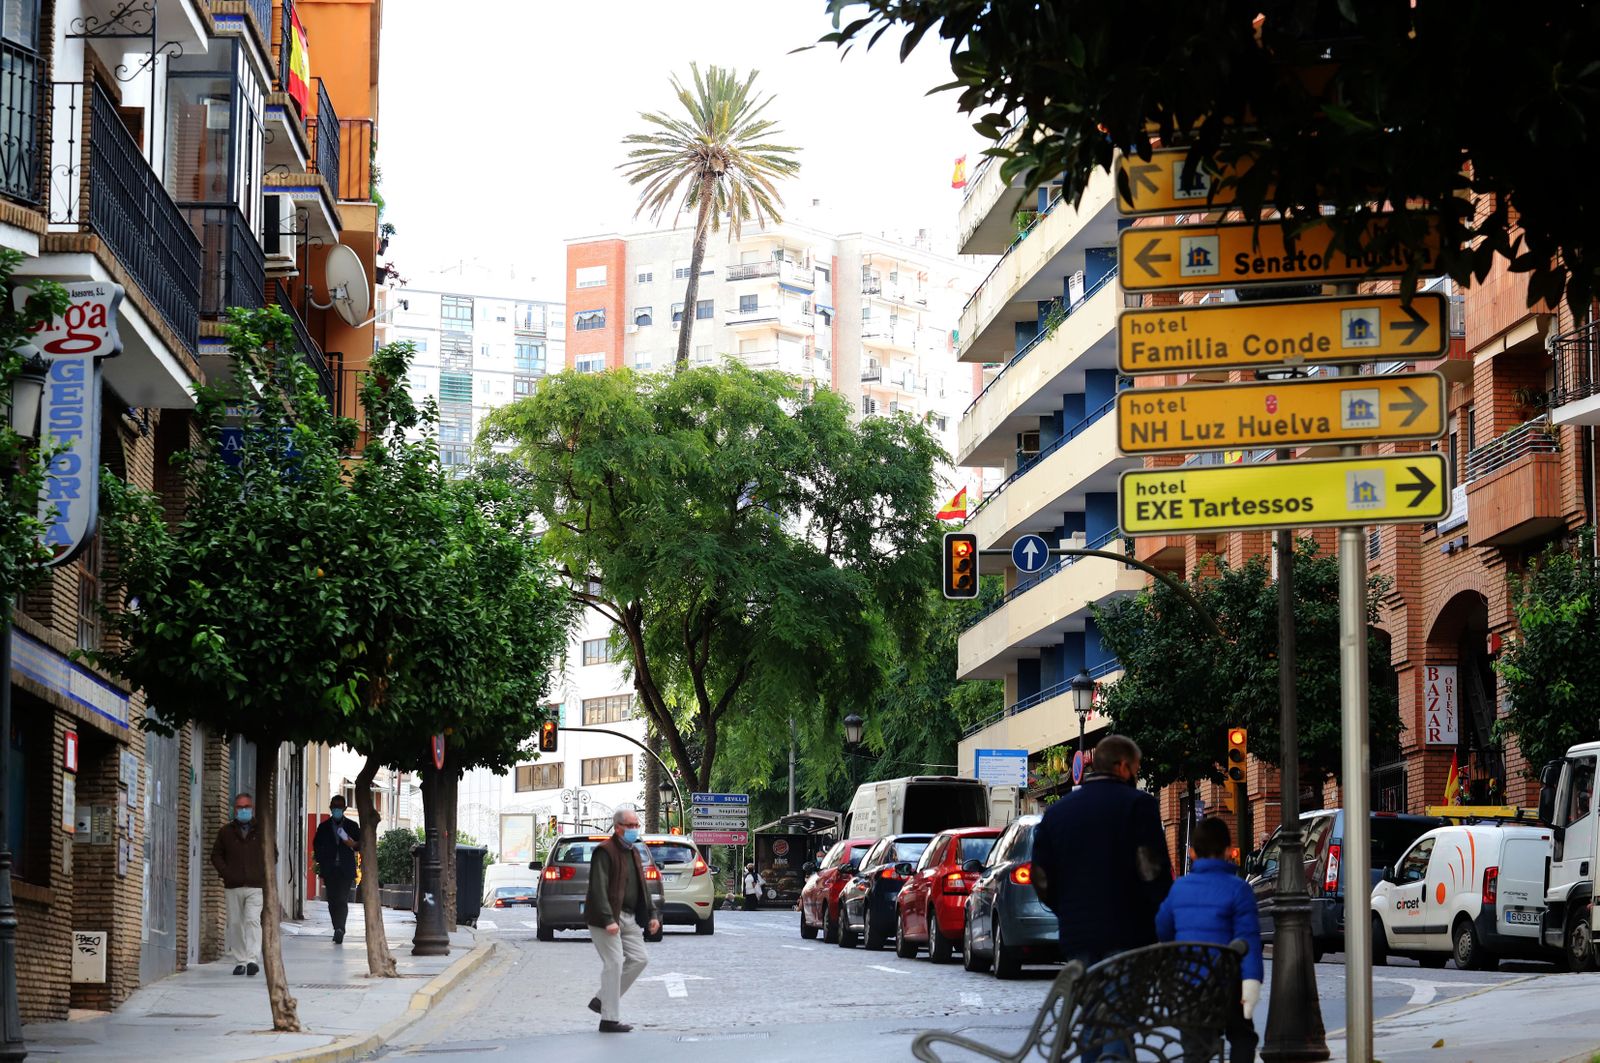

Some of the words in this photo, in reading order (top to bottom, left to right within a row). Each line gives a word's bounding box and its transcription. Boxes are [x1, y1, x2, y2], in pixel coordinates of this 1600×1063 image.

[1234, 250, 1328, 275] Senato
[1131, 316, 1187, 336] hotel
[1131, 338, 1228, 364] Familia
[1243, 332, 1331, 357] Conde
[1130, 397, 1186, 416] hotel
[1130, 421, 1168, 444] NH
[1180, 420, 1225, 442] Luz
[1238, 414, 1331, 439] Huelva
[45, 358, 85, 545] GESTORIA
[1136, 479, 1186, 496] hotel
[1136, 500, 1183, 521] EXE
[1189, 496, 1314, 518] Tartessos
[1427, 667, 1442, 742] BAZAR
[1445, 676, 1454, 732] ORIENTE
[1396, 897, 1420, 910] circet
[1511, 913, 1532, 922] 6093
